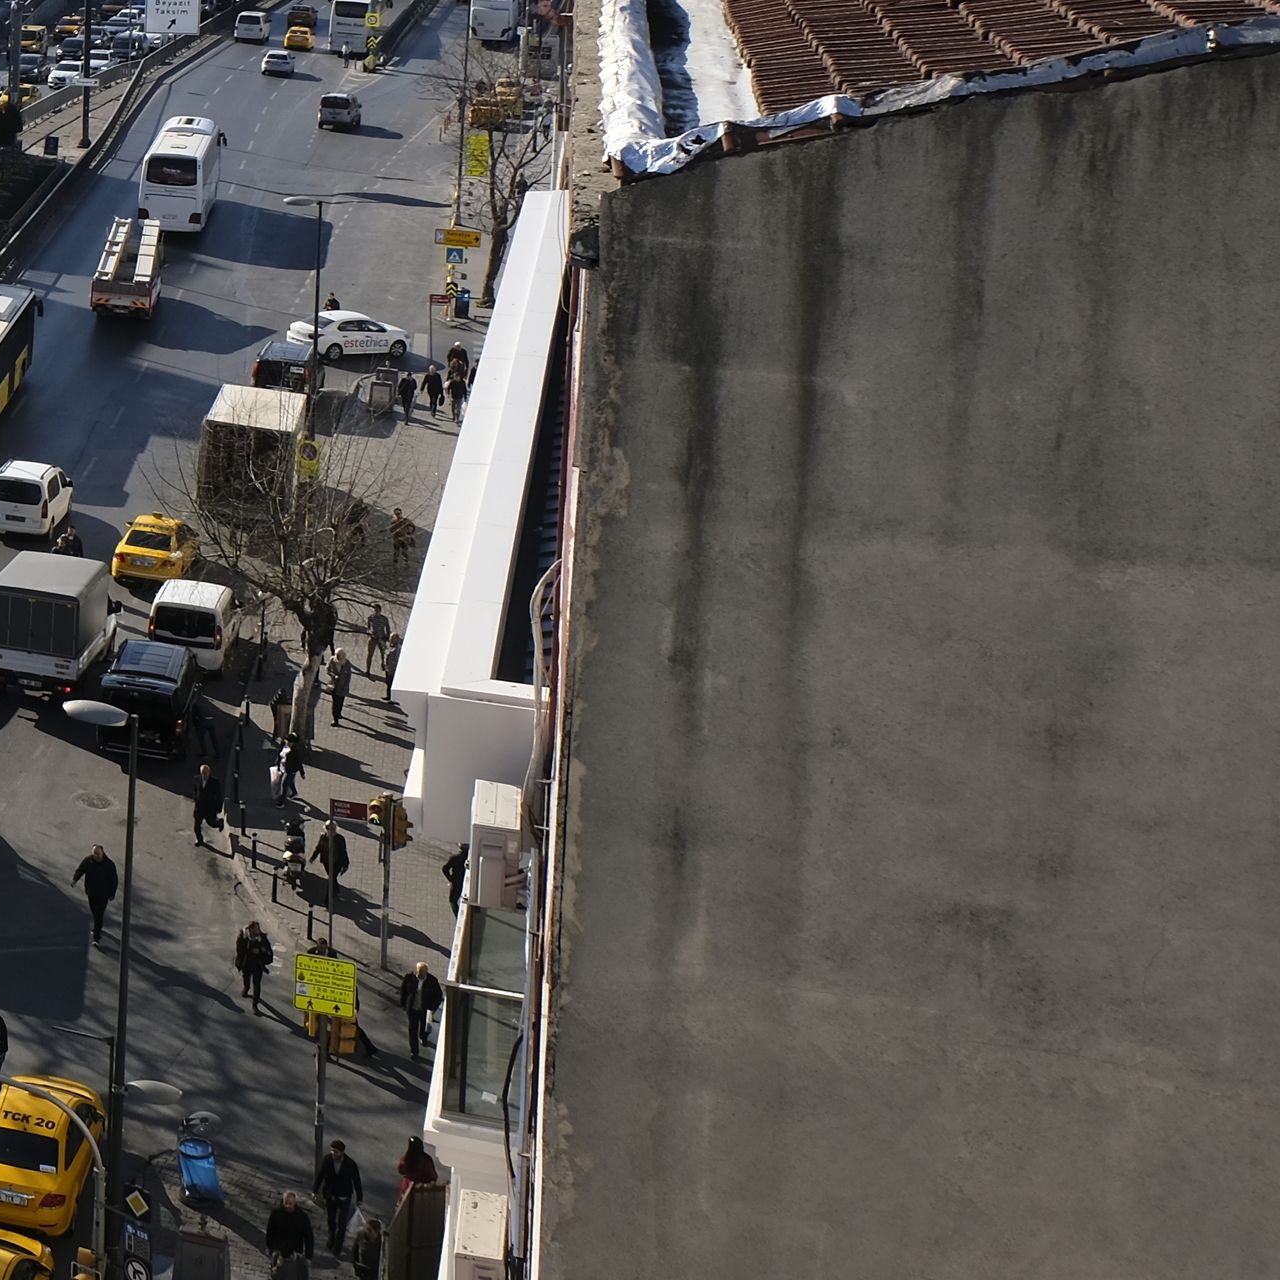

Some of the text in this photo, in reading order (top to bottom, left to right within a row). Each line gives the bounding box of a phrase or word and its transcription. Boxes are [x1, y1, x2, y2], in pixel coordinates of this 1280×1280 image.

[155, 0, 191, 7] Beyazıt
[343, 337, 389, 348] estethica
[3, 1110, 56, 1130] TCK 20
